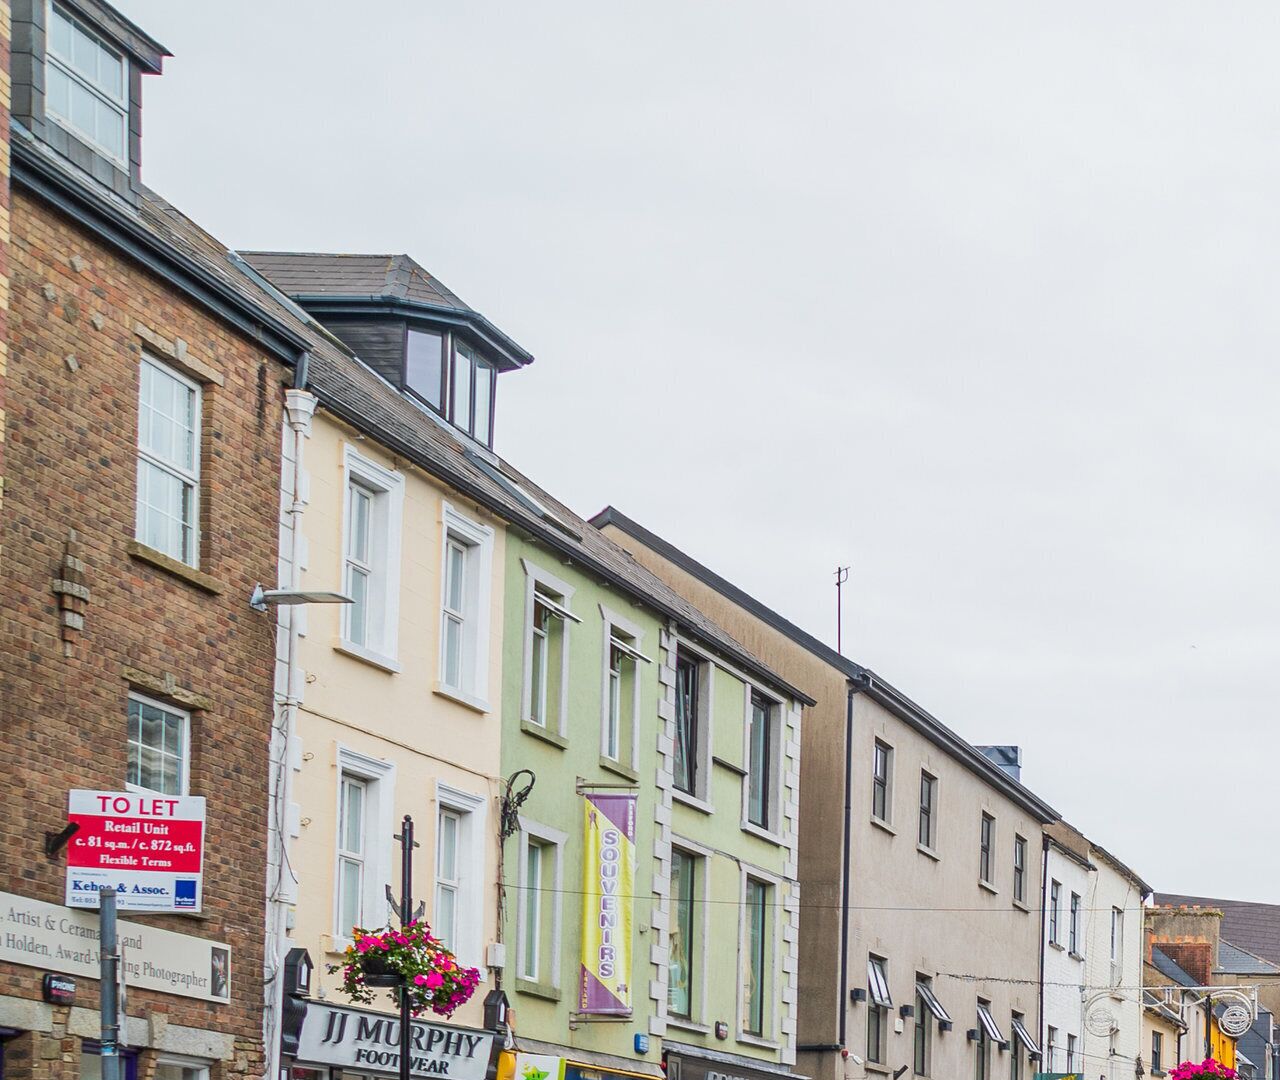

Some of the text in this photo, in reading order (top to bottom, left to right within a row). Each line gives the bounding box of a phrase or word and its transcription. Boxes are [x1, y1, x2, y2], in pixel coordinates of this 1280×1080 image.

[97, 796, 179, 816] TO LET
[104, 820, 169, 835] Retail Unit
[88, 836, 102, 847] 81
[104, 840, 130, 850] sq.m.
[150, 840, 172, 851] 872
[173, 842, 196, 854] sq.ft.
[100, 854, 172, 867] Flexible Terms
[116, 883, 127, 893] &
[132, 884, 169, 895] Assoc.
[599, 829, 619, 978] SOUVENIRS
[8, 907, 142, 950] Artist & and
[6, 933, 207, 988] Holden, Photographer
[322, 1010, 484, 1058] JJ MURPHY
